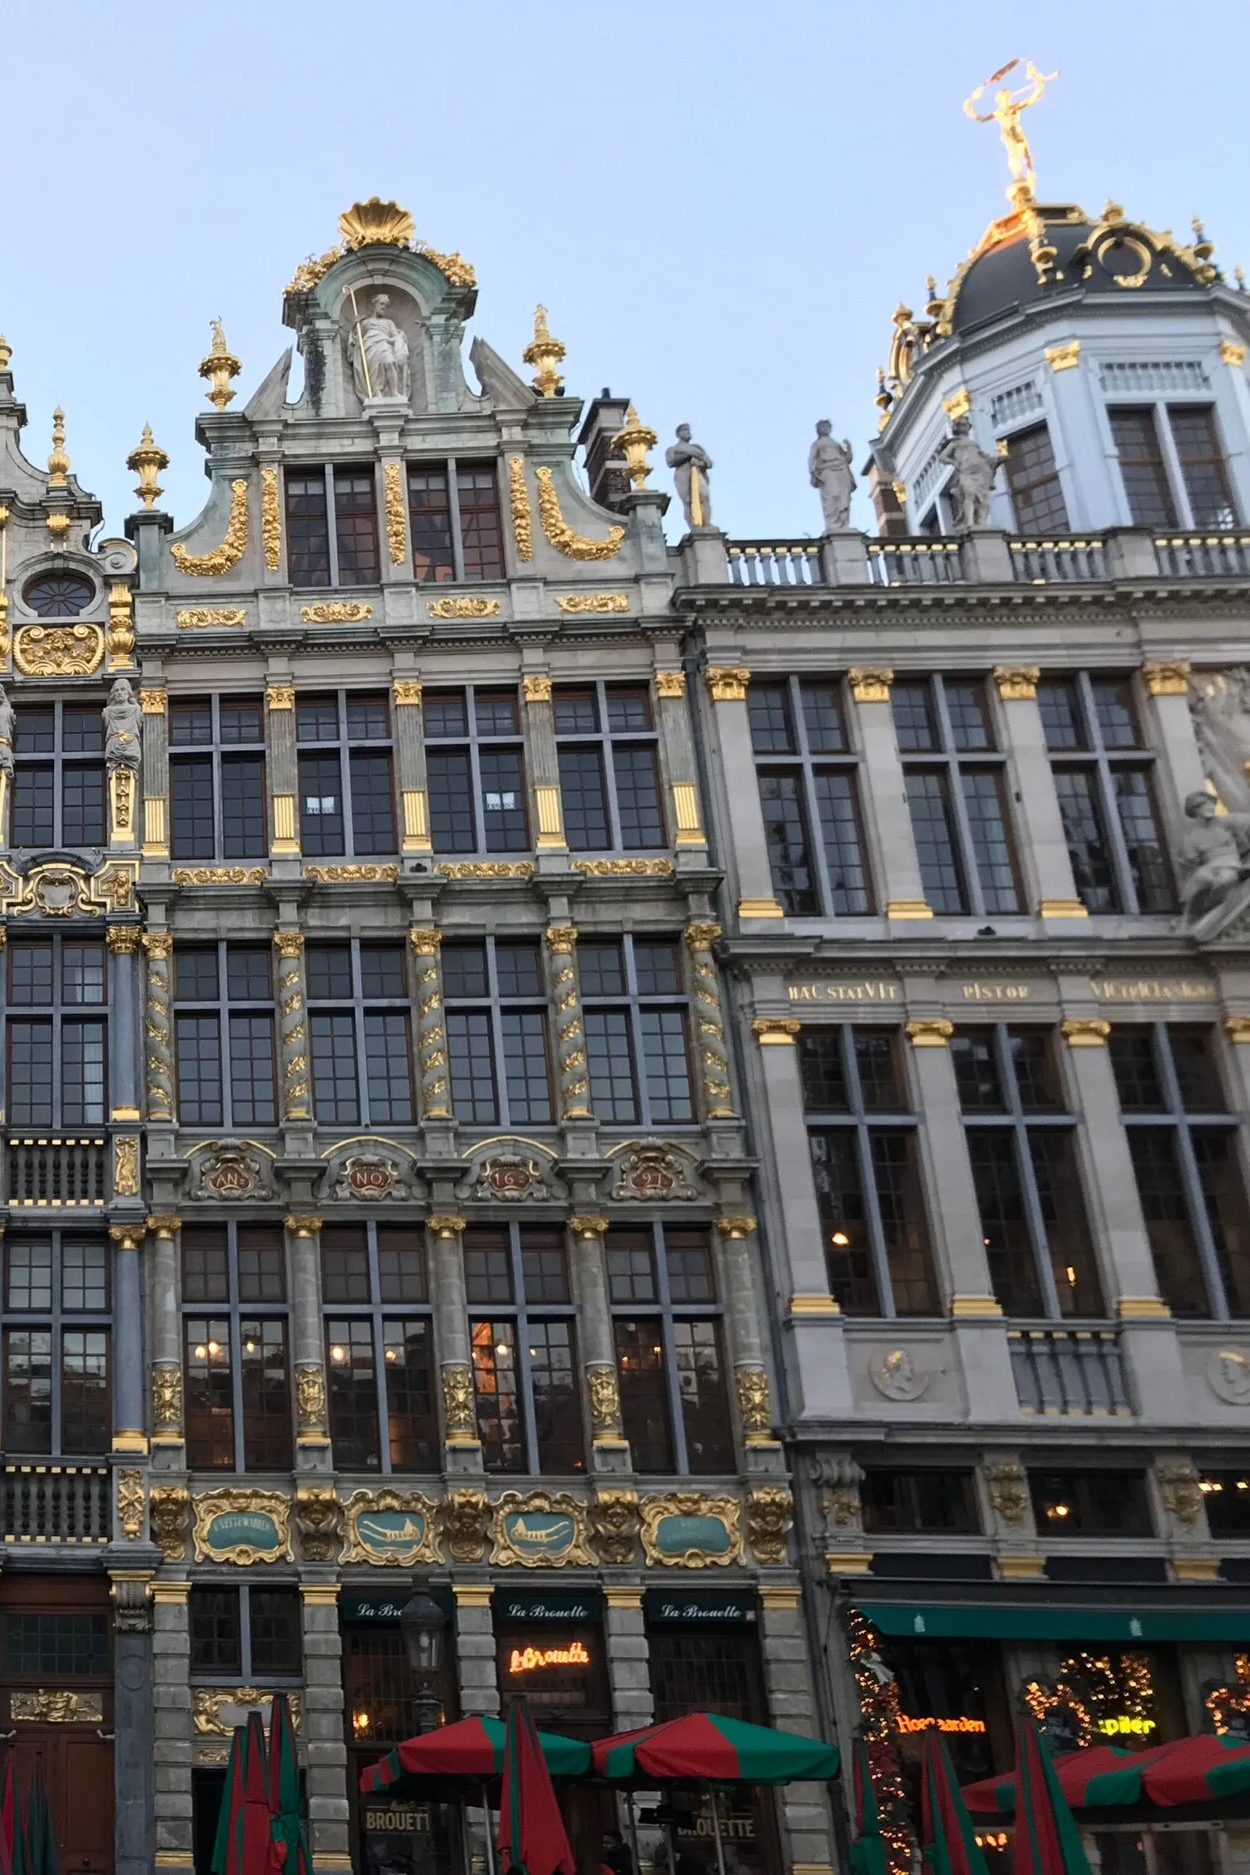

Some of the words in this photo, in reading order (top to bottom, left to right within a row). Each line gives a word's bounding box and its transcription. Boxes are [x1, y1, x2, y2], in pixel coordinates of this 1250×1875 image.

[963, 982, 1030, 999] PISTOR
[356, 1603, 376, 1616] La
[507, 1603, 527, 1617] La
[529, 1604, 590, 1617] Brouette
[659, 1604, 680, 1617] La
[682, 1604, 742, 1618] Brouette
[366, 1812, 430, 1831] BROUETT
